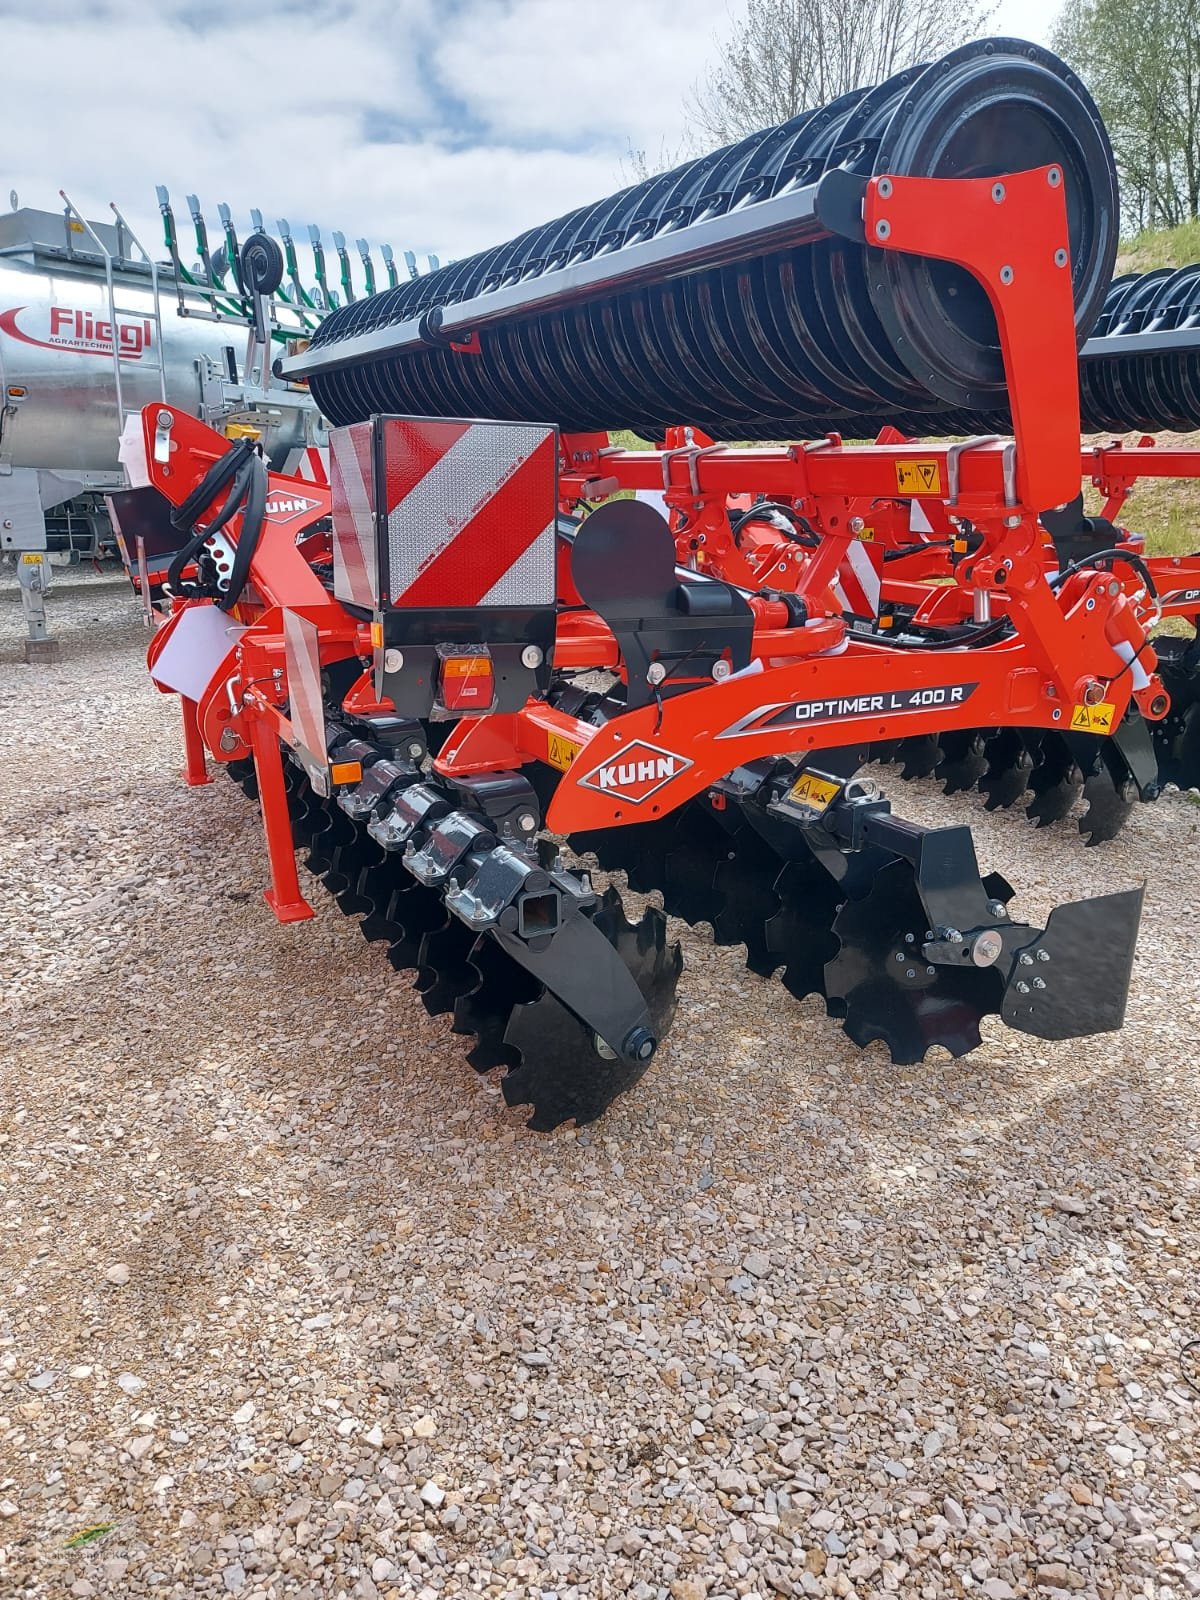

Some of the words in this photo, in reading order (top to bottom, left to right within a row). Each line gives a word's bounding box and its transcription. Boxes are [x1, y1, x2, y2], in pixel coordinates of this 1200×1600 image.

[50, 306, 152, 353] Fliegl
[48, 337, 115, 350] AGRARTECHNI
[265, 499, 308, 514] UHN
[1185, 590, 1200, 600] OP
[795, 696, 884, 719] OPTIMER
[891, 694, 902, 708] L
[908, 688, 945, 706] 400
[950, 686, 963, 701] R
[599, 756, 675, 788] KUHN
